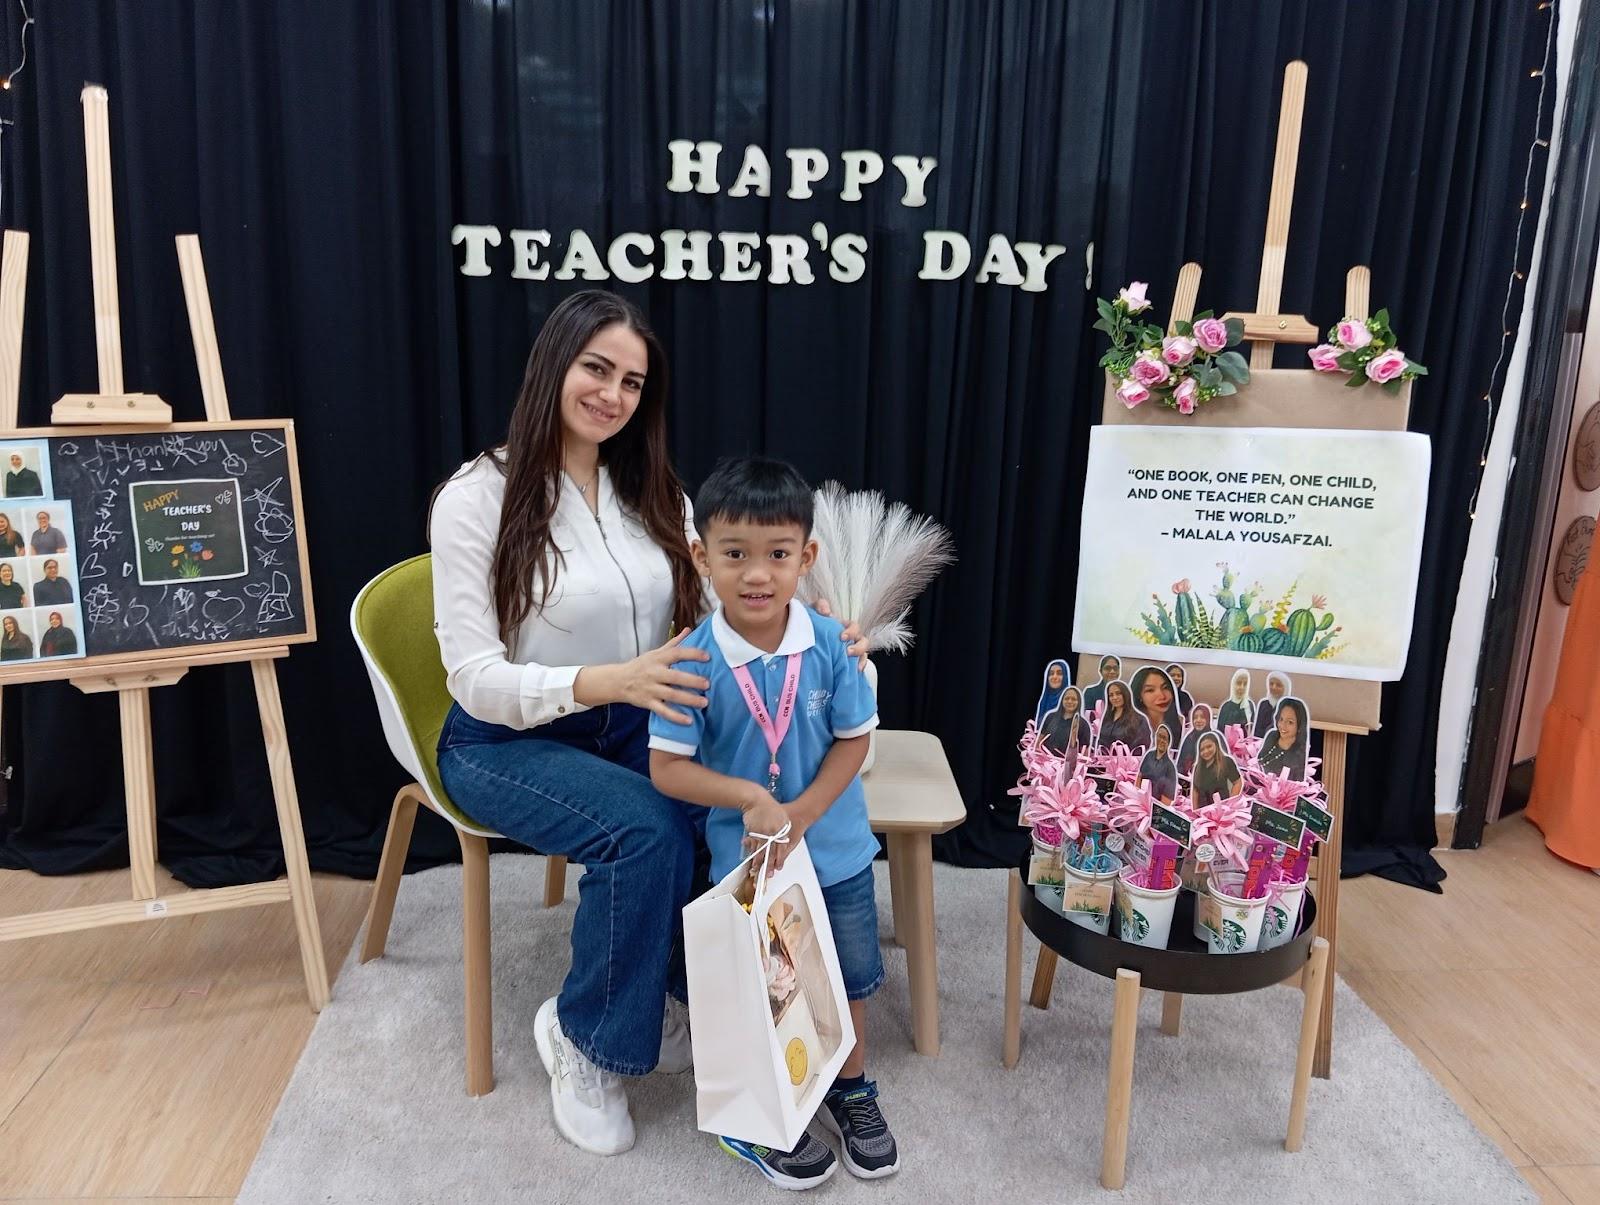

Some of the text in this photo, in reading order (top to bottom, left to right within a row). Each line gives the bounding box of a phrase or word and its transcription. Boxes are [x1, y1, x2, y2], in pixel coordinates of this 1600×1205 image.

[667, 140, 936, 207] HAPPY
[452, 222, 867, 284] TEACHER'S
[918, 231, 1066, 291] DAY
[1168, 471, 1212, 484] BOOK,
[1217, 472, 1248, 483] ONE
[1252, 473, 1285, 487] PEN,
[1290, 475, 1322, 486] ONE
[1327, 476, 1376, 491] CHILD,
[143, 489, 179, 512] HAPPY
[1127, 488, 1374, 509] AND ONE TEACHER CAN CHANGE
[163, 504, 212, 516] TEACHER'S
[1195, 510, 1225, 521] THE
[181, 521, 200, 531] DAY
[1173, 528, 1235, 541] MALALA
[1240, 531, 1332, 546] YOUSAFZAI.
